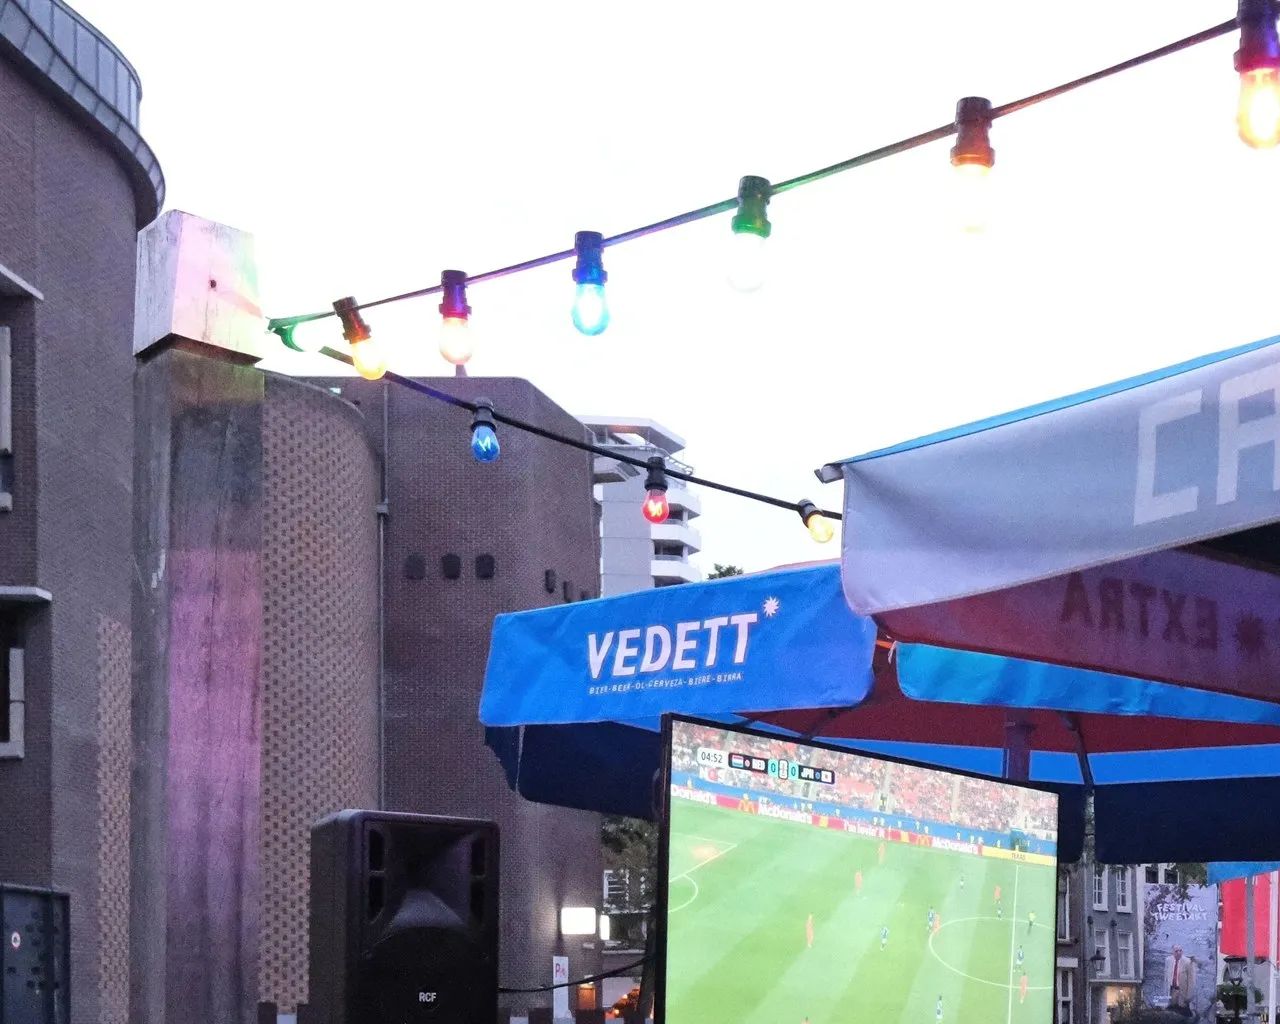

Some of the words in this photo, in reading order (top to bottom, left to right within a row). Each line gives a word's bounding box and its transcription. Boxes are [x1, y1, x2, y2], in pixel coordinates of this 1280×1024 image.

[587, 612, 758, 680] VEDETT
[700, 751, 723, 764] 04:52
[1156, 903, 1206, 912] FESTIVAL
[1151, 911, 1208, 920] TWEETAKT
[418, 991, 437, 1003] RCF
